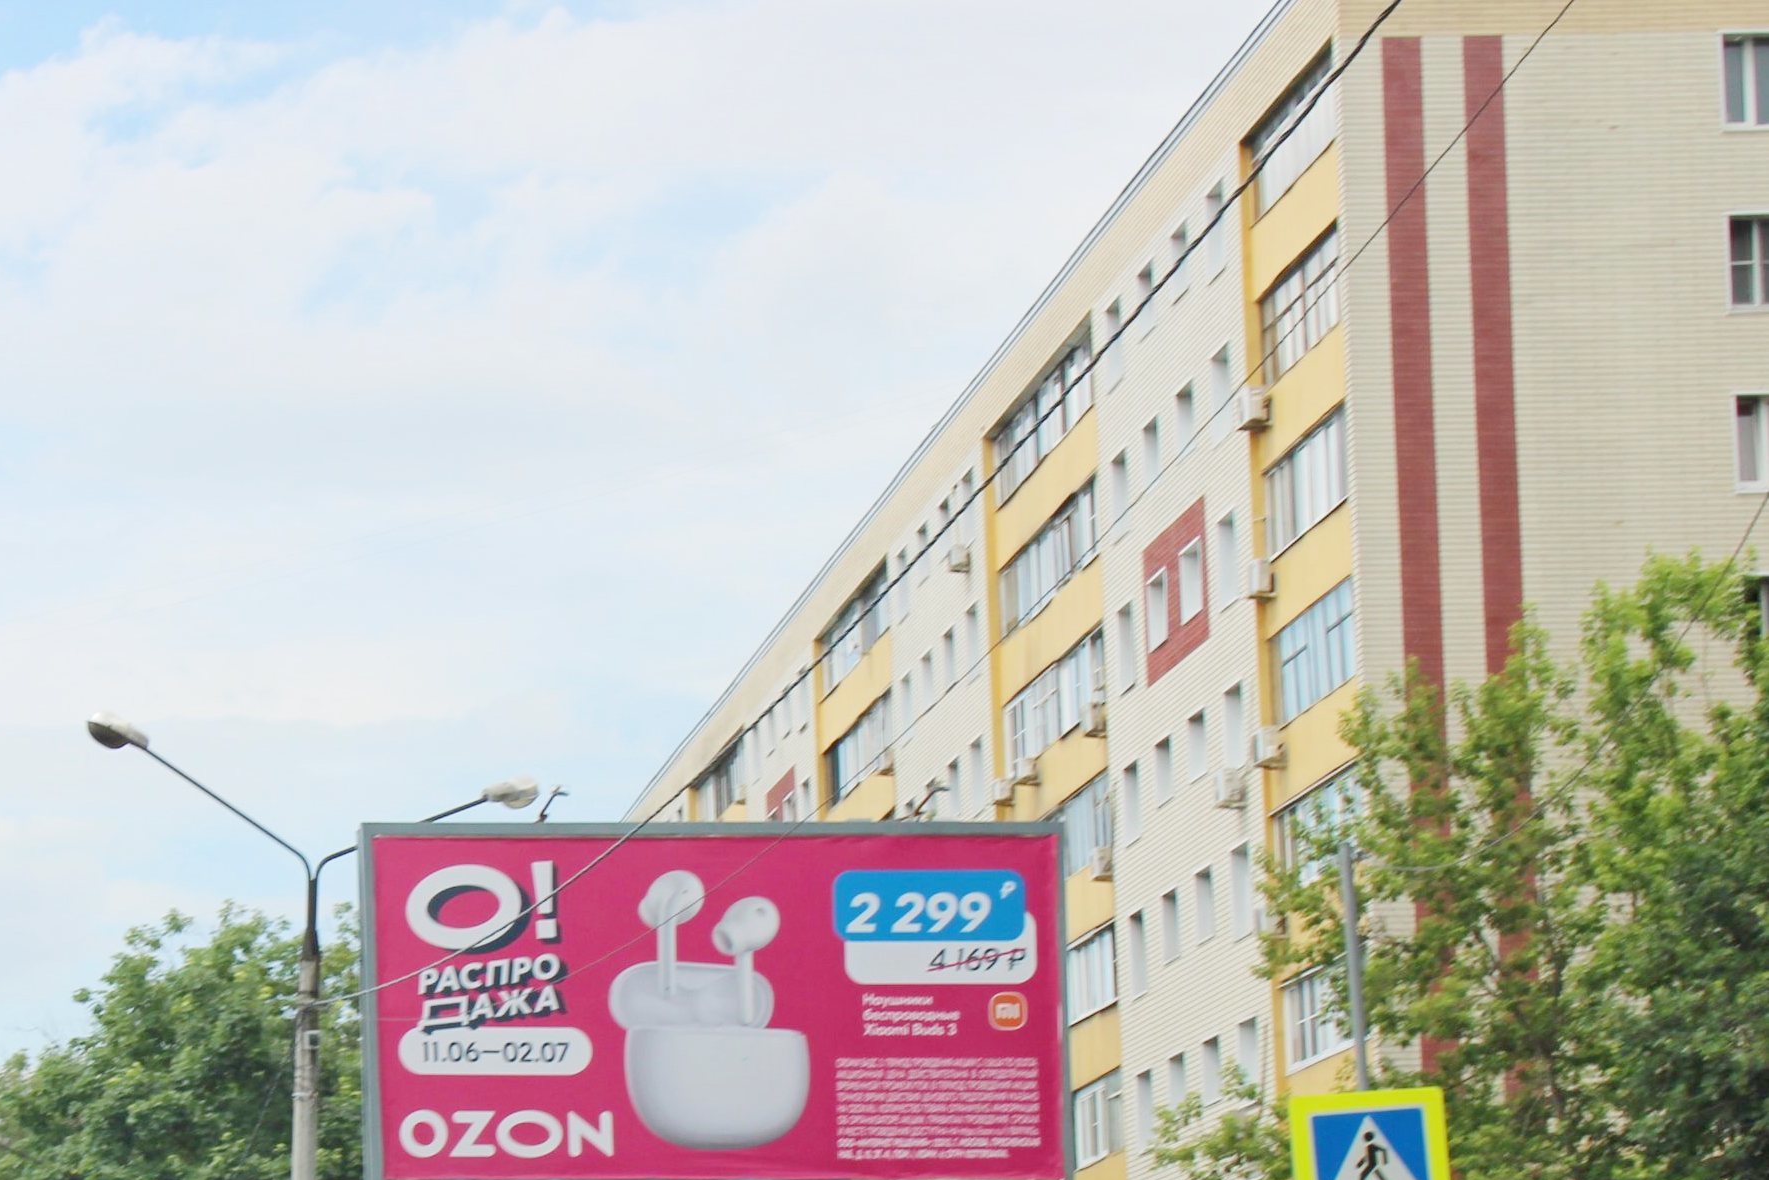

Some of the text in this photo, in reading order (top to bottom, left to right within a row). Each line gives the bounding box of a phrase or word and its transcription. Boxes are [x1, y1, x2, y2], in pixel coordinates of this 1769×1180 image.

[417, 953, 561, 995] РАСПРО
[417, 985, 560, 1032] ДАЖА
[398, 1108, 615, 1159] OZON
